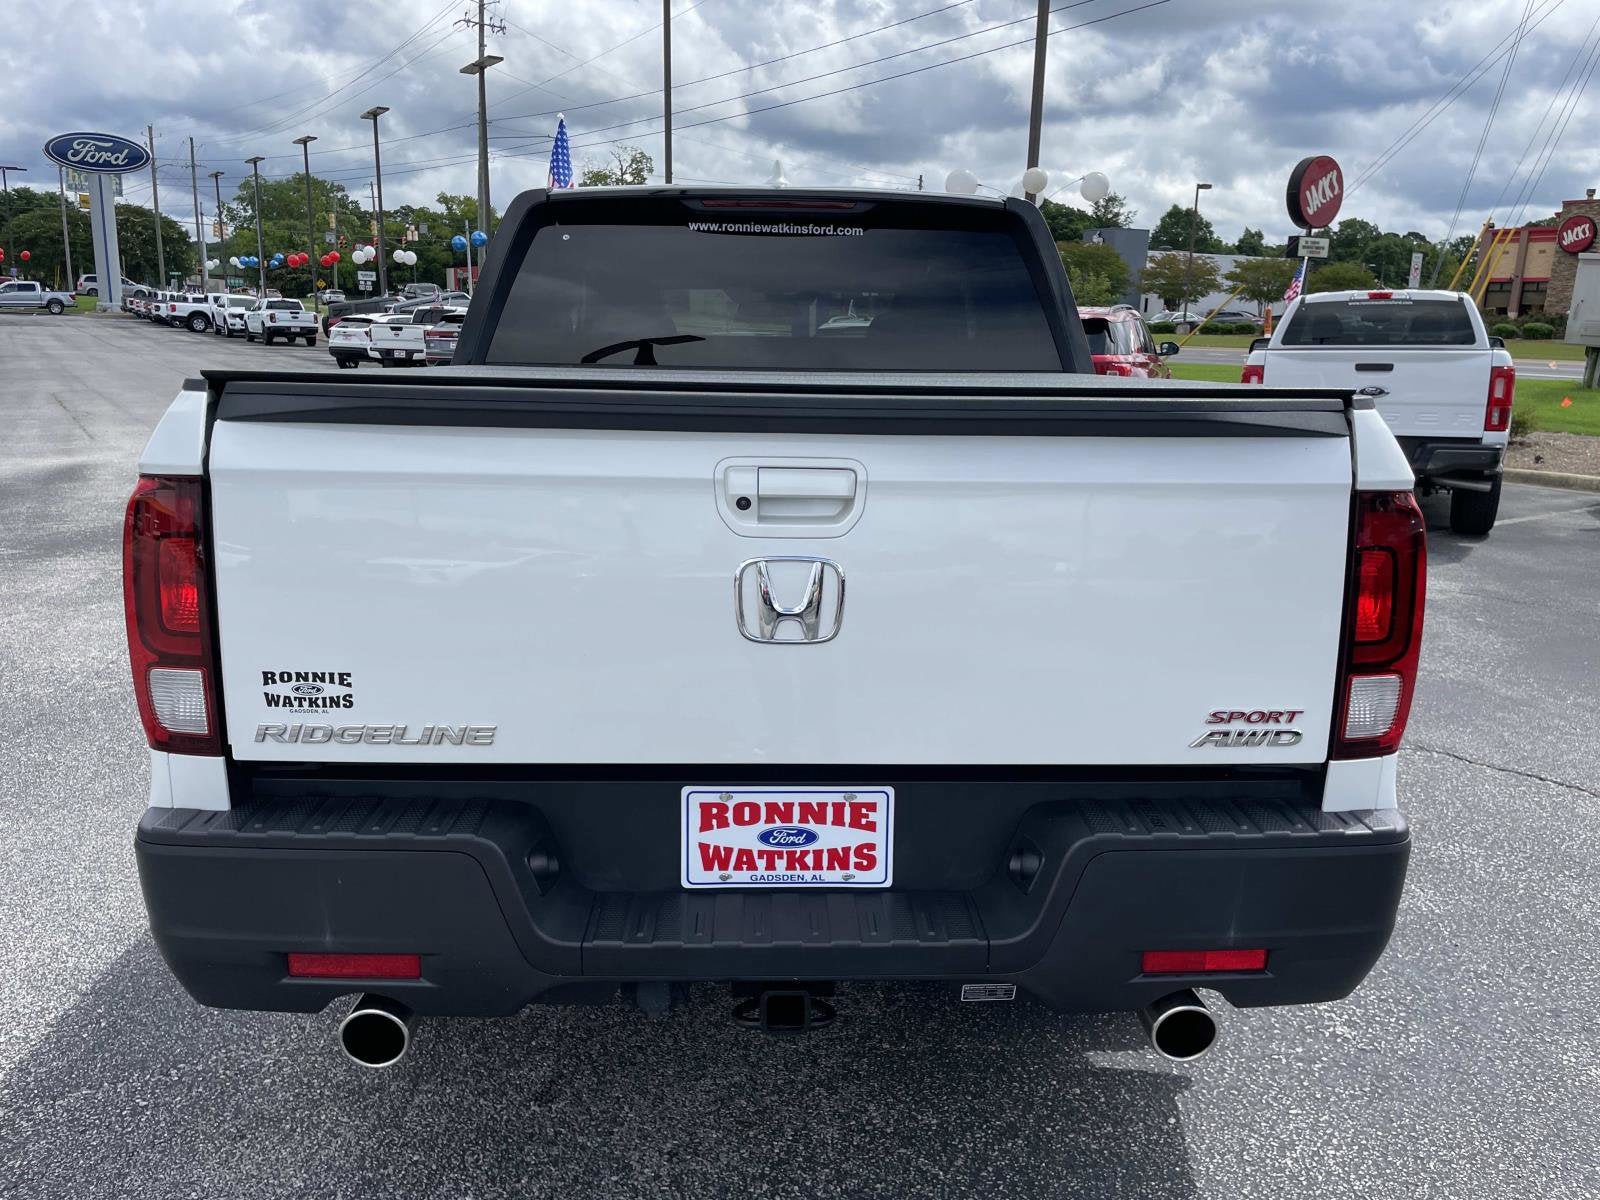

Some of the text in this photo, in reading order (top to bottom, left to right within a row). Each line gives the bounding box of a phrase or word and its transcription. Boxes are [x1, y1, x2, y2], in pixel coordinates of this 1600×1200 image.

[67, 139, 128, 165] Ford
[688, 221, 864, 236] www.ronniewatkinsford.com
[261, 670, 353, 688] RONNIE
[298, 685, 318, 694] Ford
[263, 691, 354, 709] WATKINS
[1205, 710, 1304, 724] SPORT
[254, 722, 497, 746] RIDGELINE
[1188, 729, 1303, 748] AWD
[698, 801, 878, 833] RONNIE
[769, 829, 806, 845] Ford
[698, 842, 877, 872] WATKINS
[750, 874, 826, 883] GADSDEN, AL
